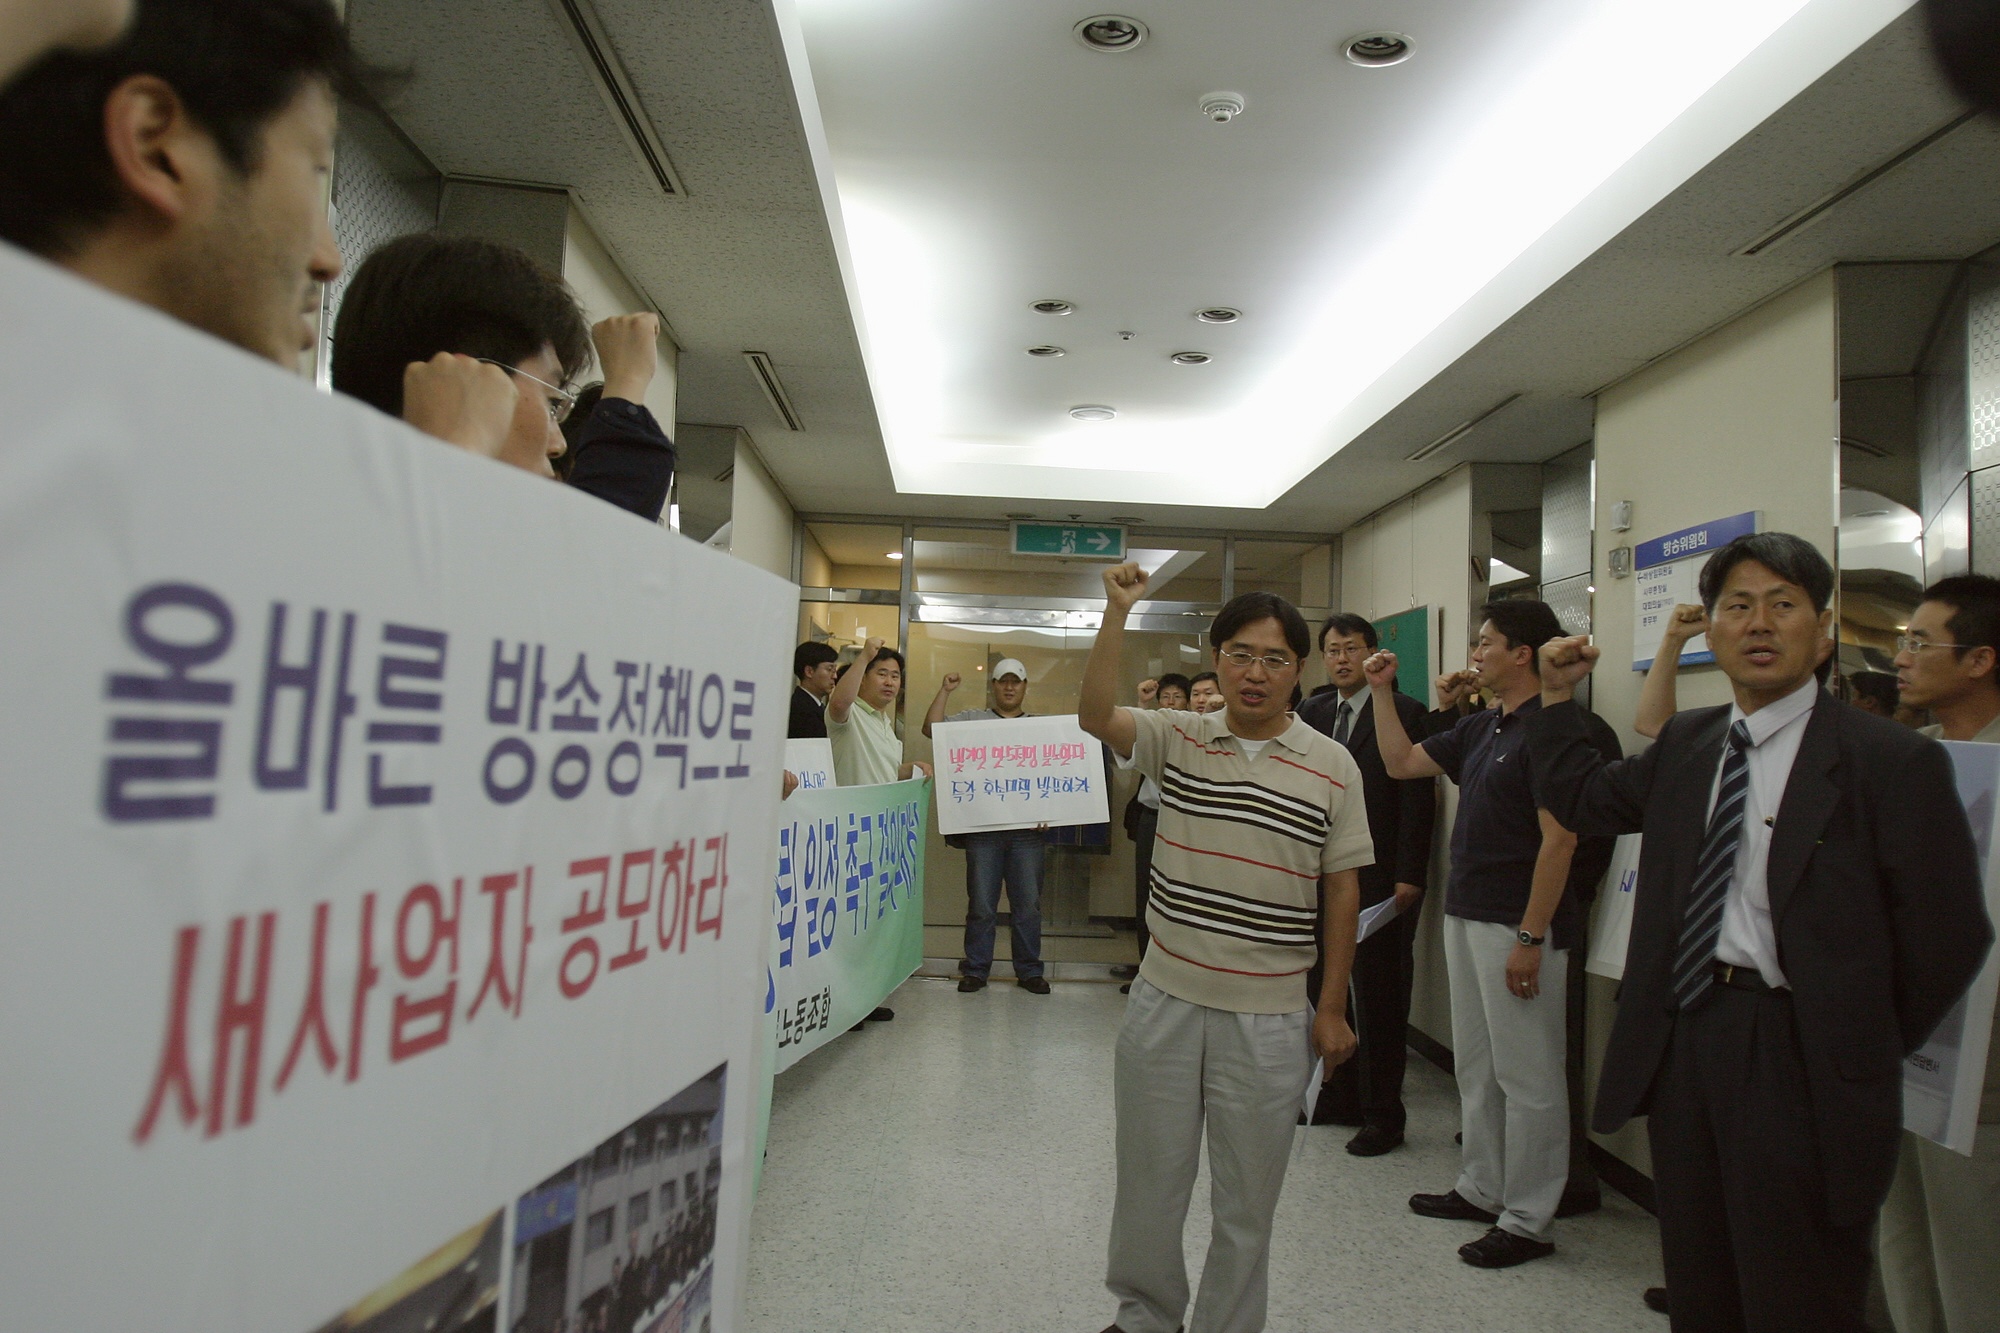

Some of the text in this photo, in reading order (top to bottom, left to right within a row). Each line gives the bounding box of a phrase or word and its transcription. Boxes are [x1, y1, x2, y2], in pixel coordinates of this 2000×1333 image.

[1663, 531, 1707, 556] 방송위원회
[99, 580, 758, 826] 올바른 방송정책으로
[803, 816, 840, 959] 일정
[844, 812, 875, 937] 촉구
[131, 832, 731, 1146] 새사업자 공모하라
